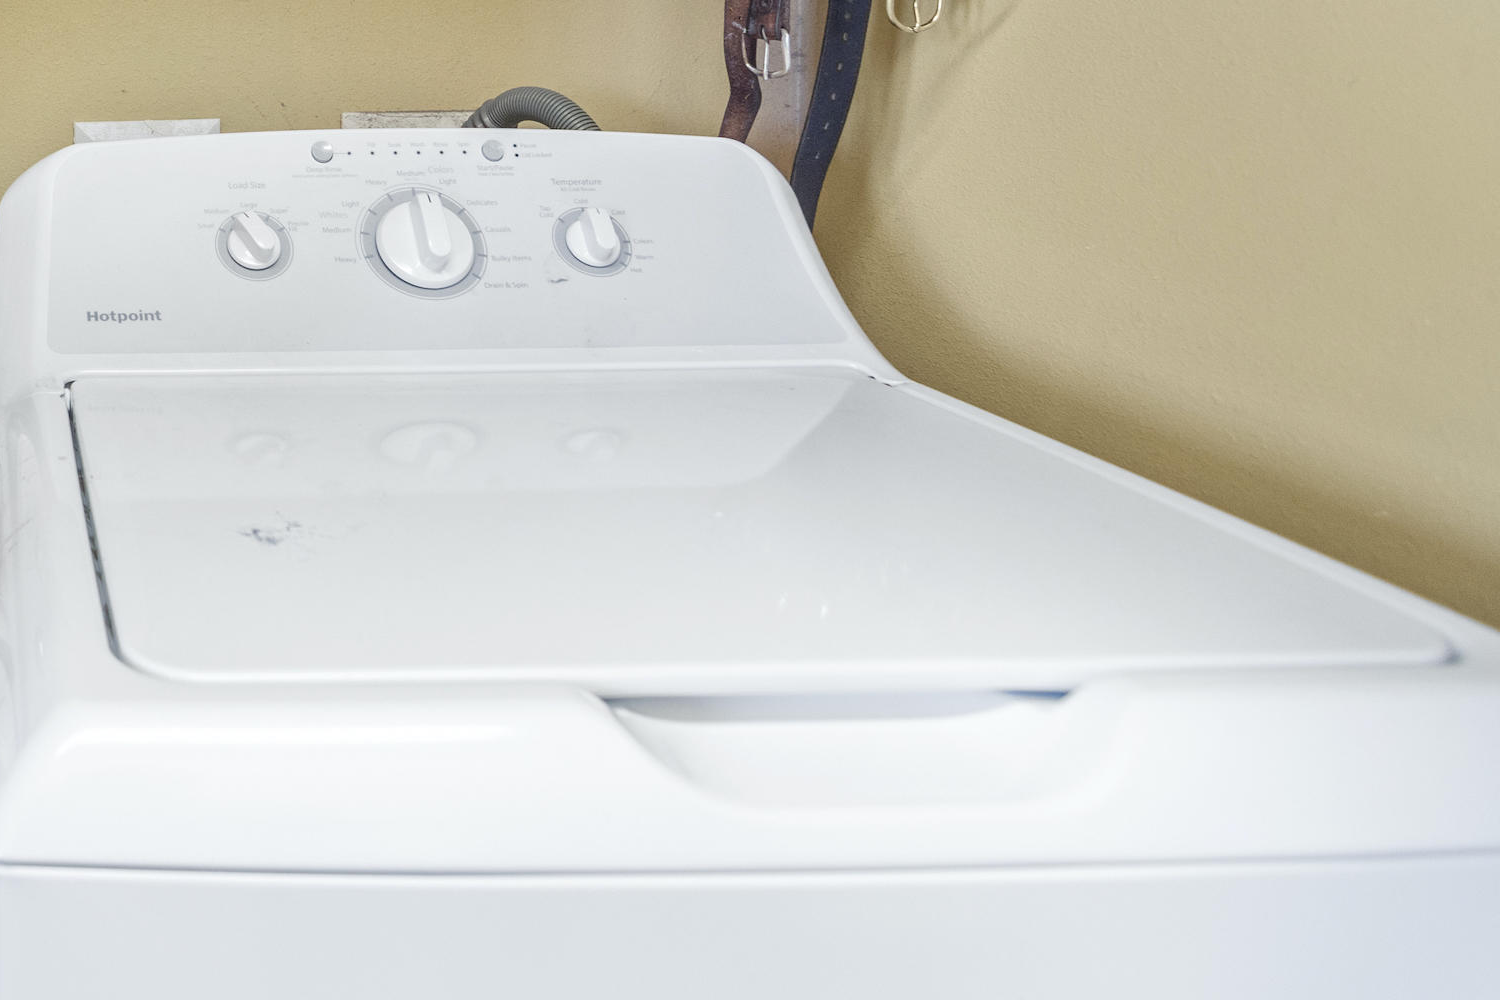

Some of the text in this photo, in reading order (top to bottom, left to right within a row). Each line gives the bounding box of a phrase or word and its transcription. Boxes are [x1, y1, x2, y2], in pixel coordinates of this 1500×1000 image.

[227, 181, 267, 190] Load Size
[550, 177, 603, 187] Temperature
[340, 201, 360, 209] Light
[322, 226, 352, 234] Medium
[334, 256, 357, 264] Heavy
[86, 309, 162, 323] Hotpoint
